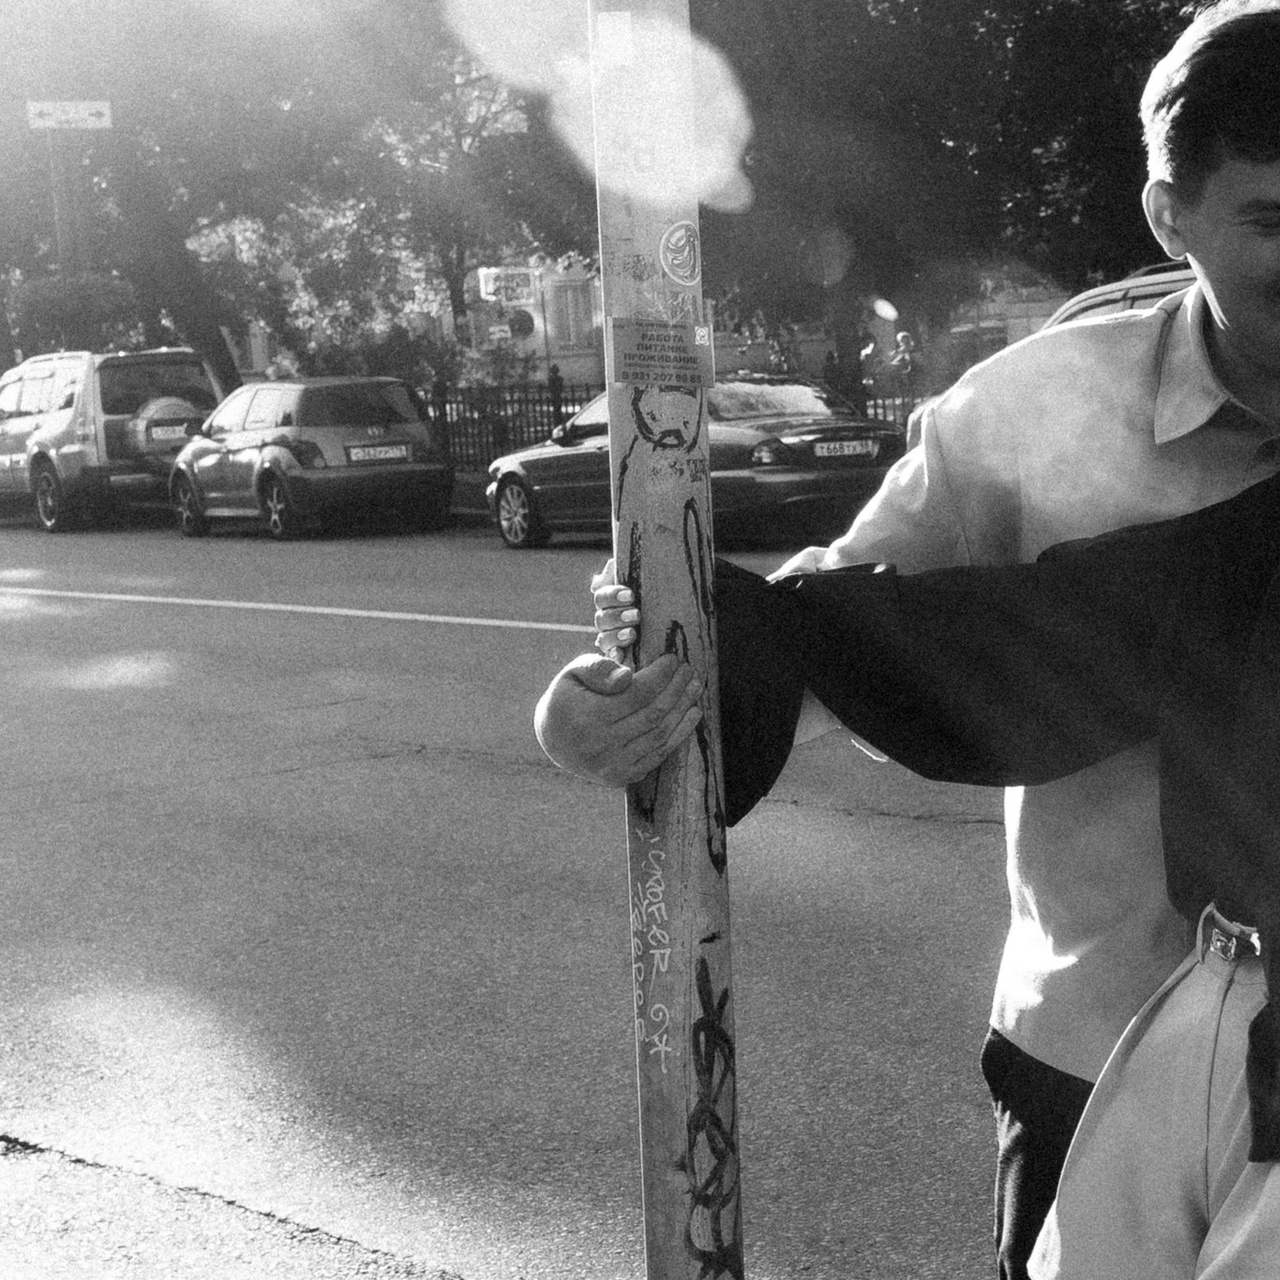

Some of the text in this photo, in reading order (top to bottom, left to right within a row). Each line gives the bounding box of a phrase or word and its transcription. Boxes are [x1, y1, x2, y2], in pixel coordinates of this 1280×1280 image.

[641, 333, 684, 343] РАБОТА
[636, 343, 688, 354] ПИТАНИЕ
[623, 353, 698, 365] ПРОЖИВАНИЕ
